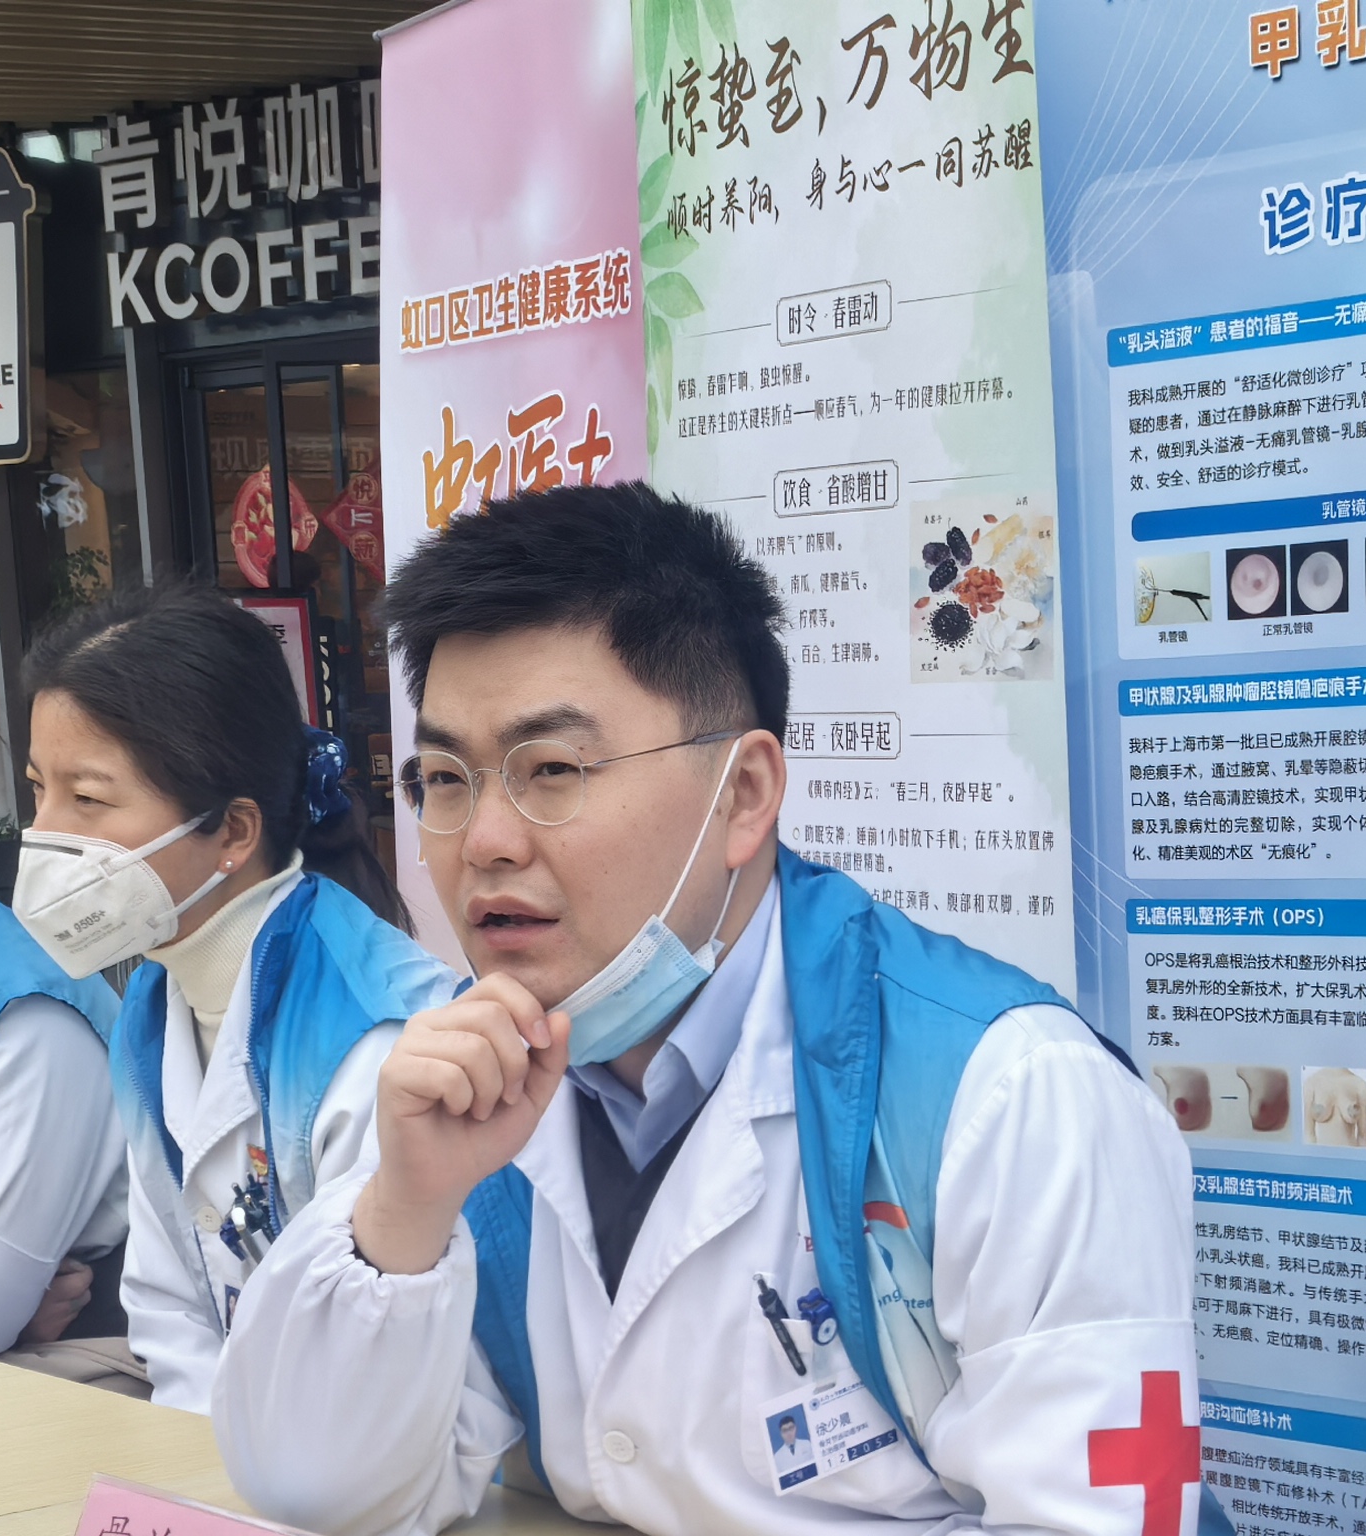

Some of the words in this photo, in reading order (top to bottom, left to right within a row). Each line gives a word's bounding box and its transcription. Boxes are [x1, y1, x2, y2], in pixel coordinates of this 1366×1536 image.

[400, 251, 630, 351] 虹口区卫生健康系统
[1158, 630, 1188, 644] 乳管镜
[1262, 621, 1314, 637] 正常乳管镜
